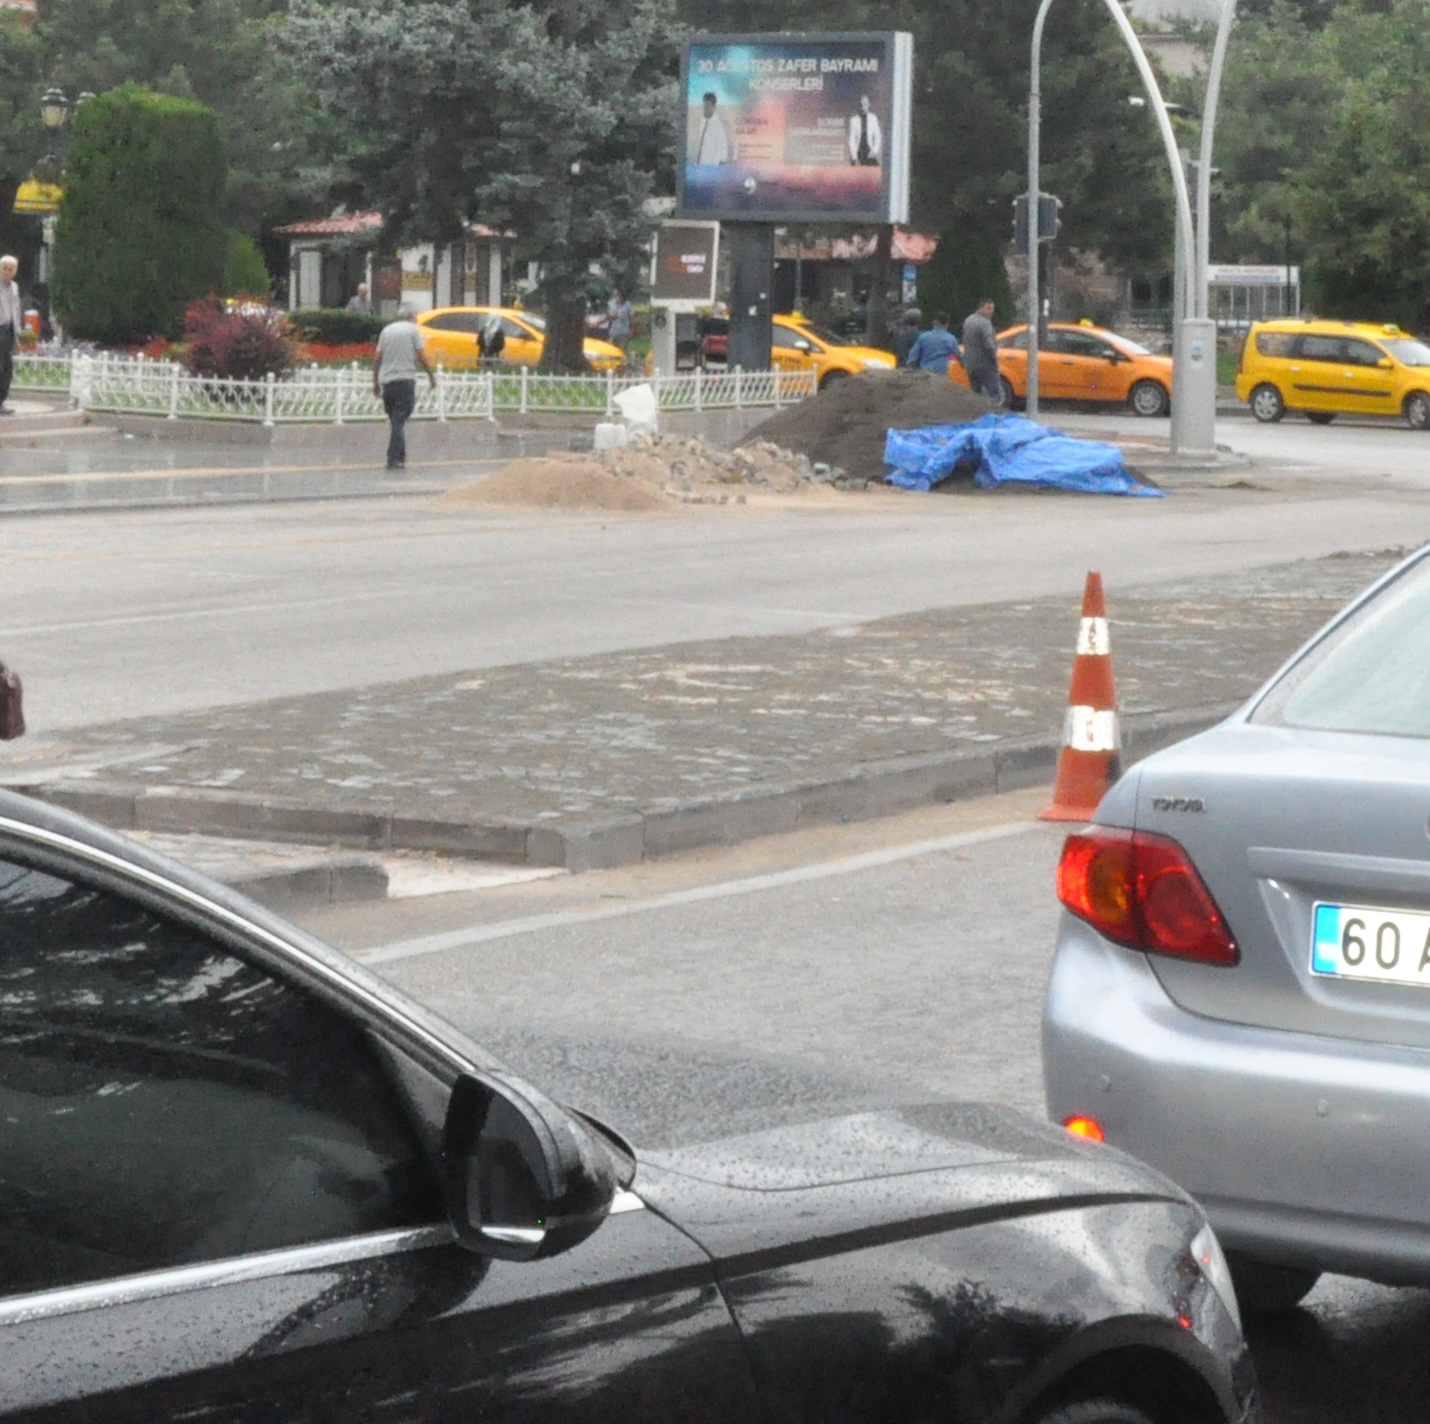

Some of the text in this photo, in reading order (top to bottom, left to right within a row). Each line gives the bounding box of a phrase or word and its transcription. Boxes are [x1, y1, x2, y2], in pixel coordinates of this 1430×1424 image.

[778, 58, 817, 72] ZAFER
[821, 58, 879, 73] BAYRAMI
[749, 75, 823, 91] KONSERLERİ
[1341, 917, 1401, 970] 60
